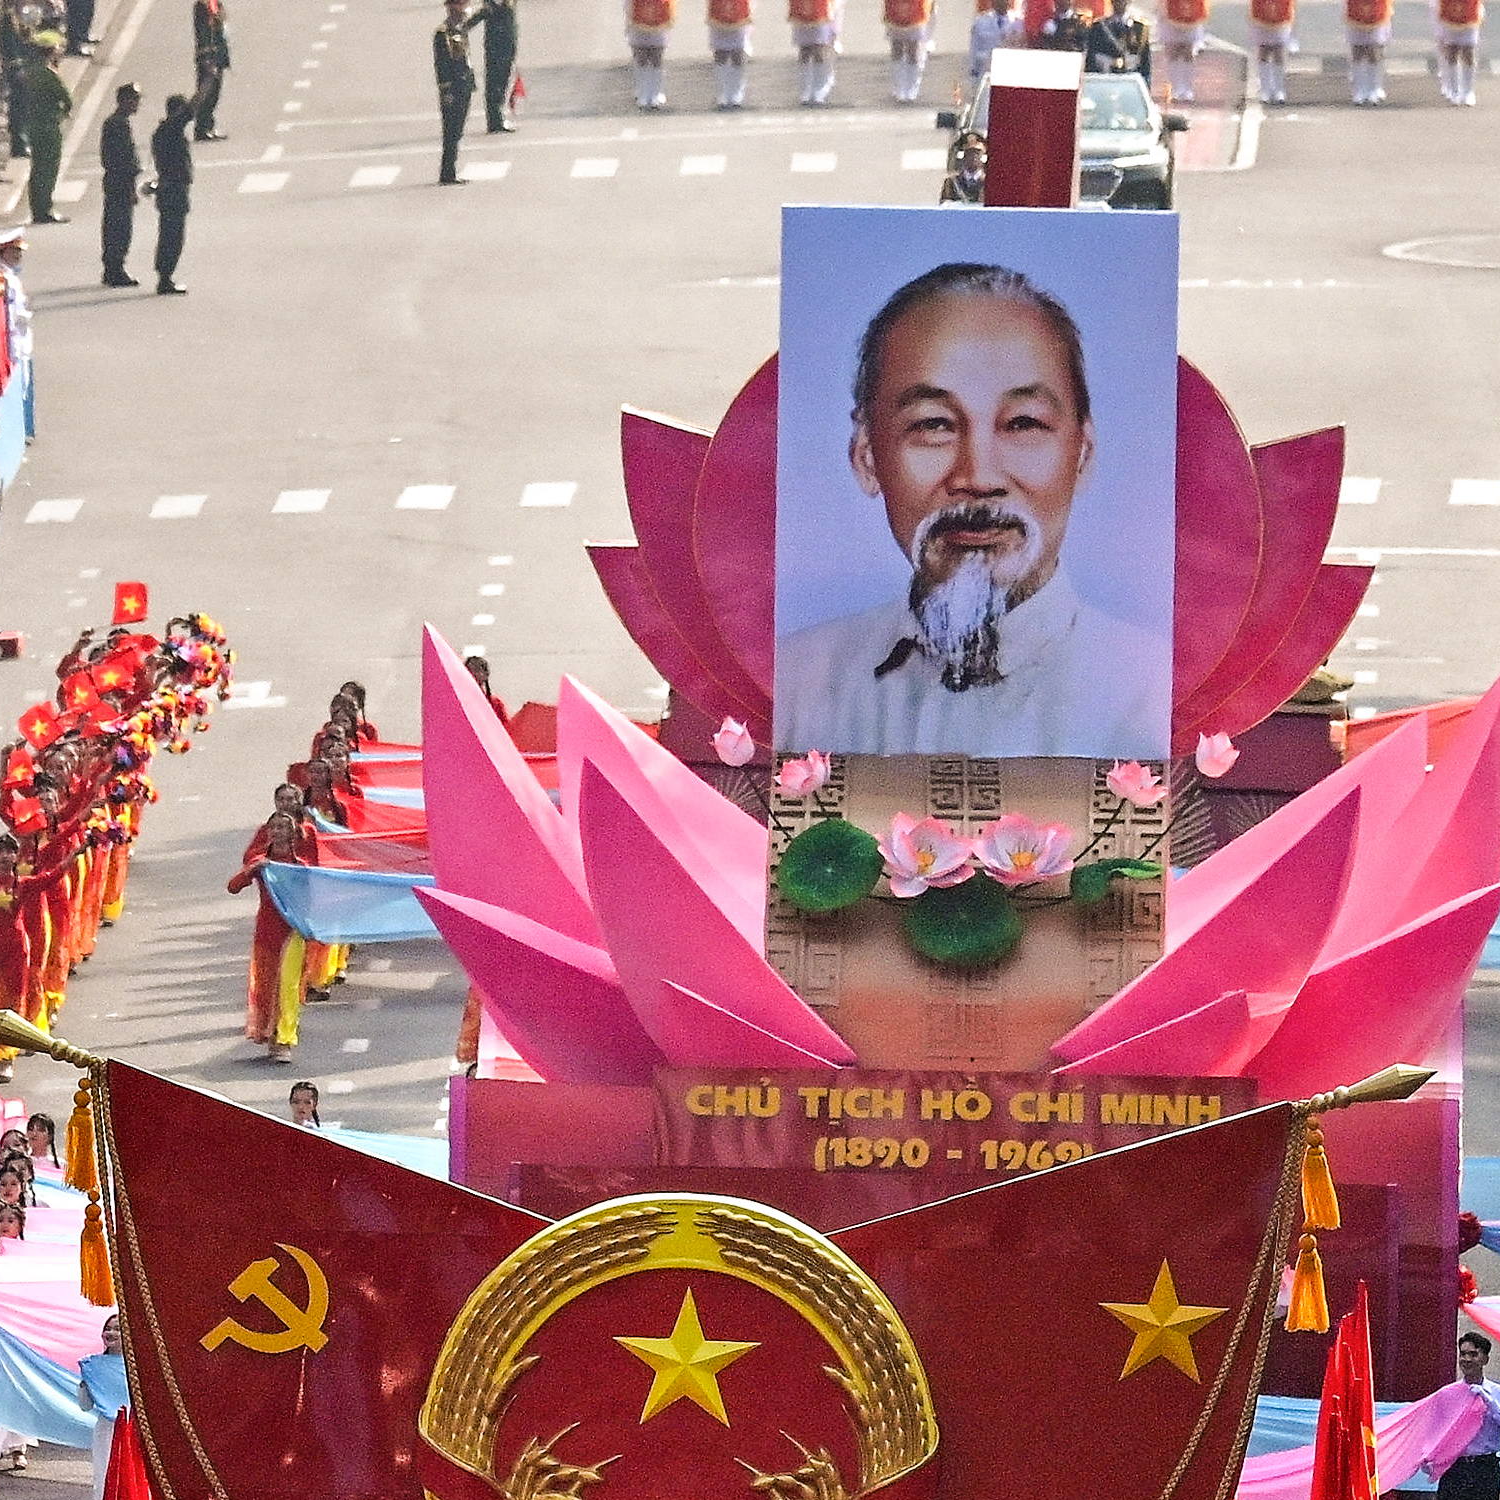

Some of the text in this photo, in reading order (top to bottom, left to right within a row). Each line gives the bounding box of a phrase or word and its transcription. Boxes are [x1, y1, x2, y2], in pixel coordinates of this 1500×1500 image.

[686, 1076, 1220, 1126] CHỦ TỊCH HỒ CHÍ MINH
[814, 1137, 929, 1172] (1890
